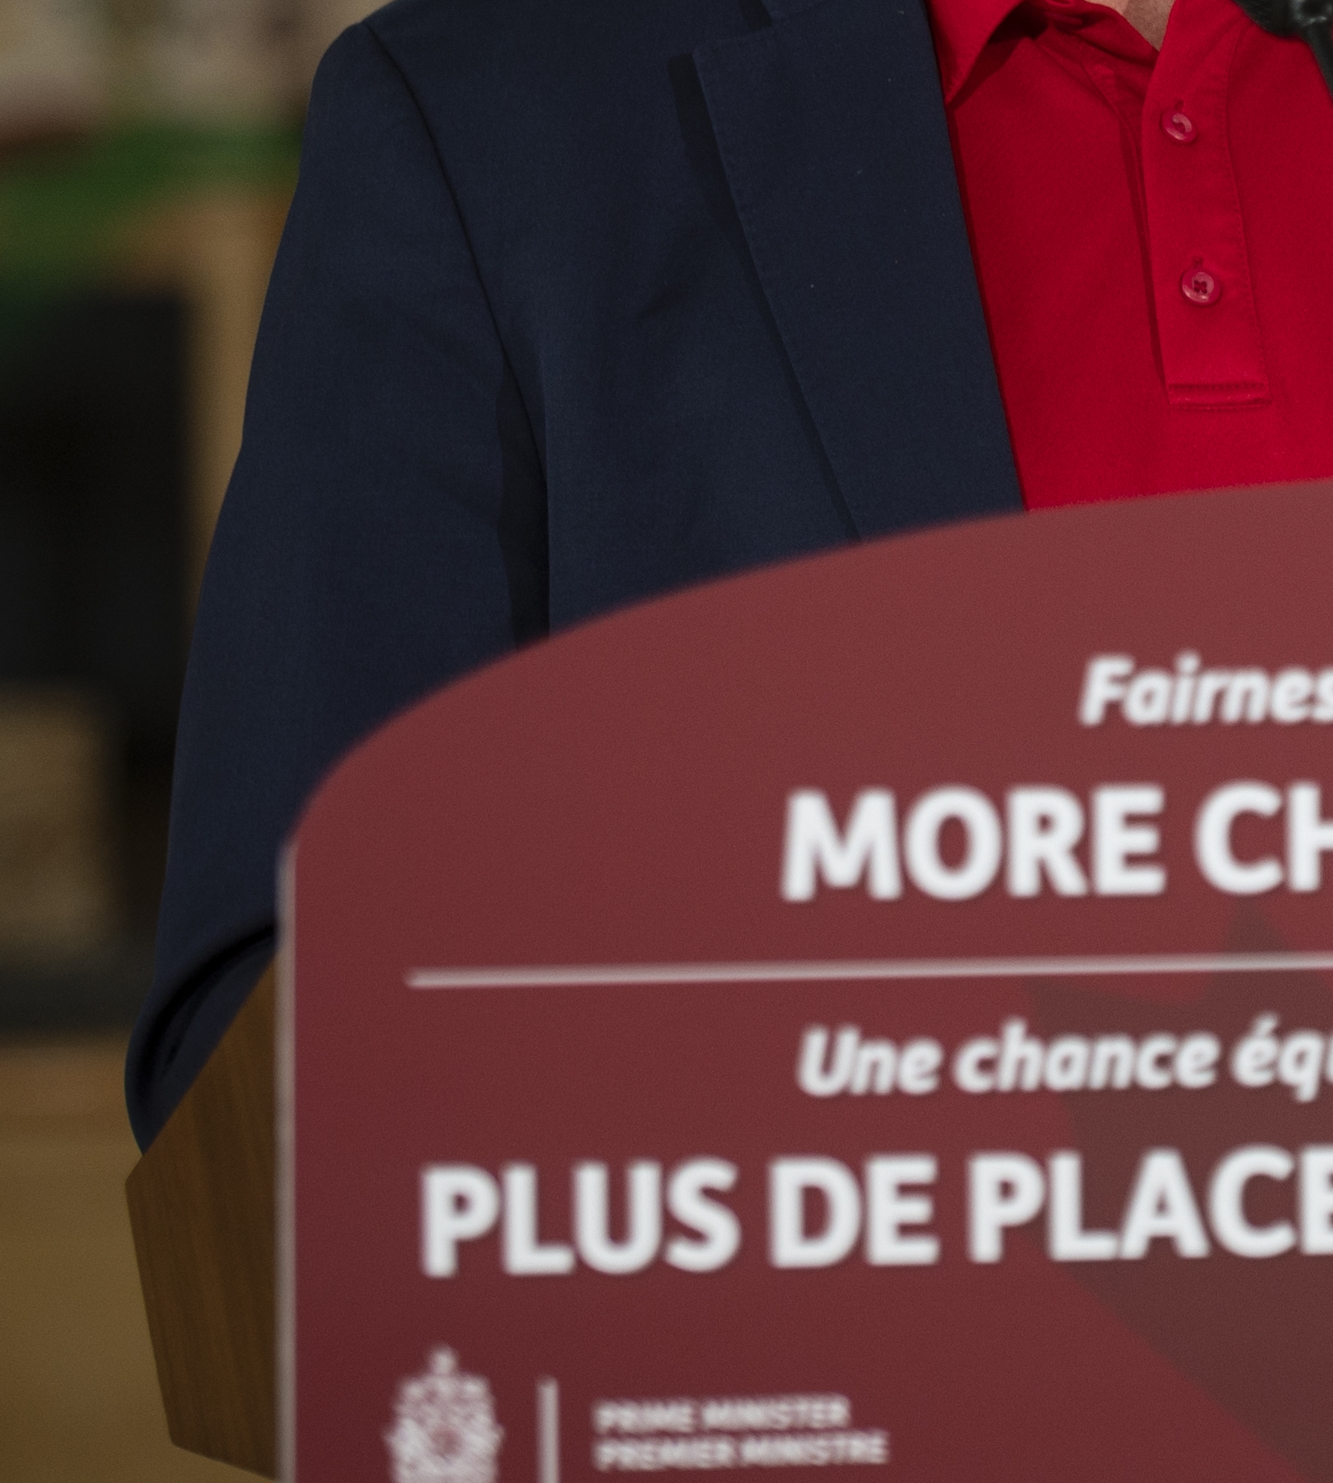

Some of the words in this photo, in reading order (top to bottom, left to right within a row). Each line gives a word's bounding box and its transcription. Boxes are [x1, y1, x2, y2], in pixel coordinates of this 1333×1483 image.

[782, 784, 1166, 901] MORE
[798, 1024, 942, 1096] Une
[954, 1019, 1220, 1092] chance
[423, 1158, 740, 1276] PLUS
[769, 1155, 939, 1268] DE
[595, 1399, 698, 1433] PRIME
[702, 1394, 850, 1430] MINISTER
[595, 1435, 736, 1471] PREMIER
[740, 1429, 888, 1467] MINISTRE
